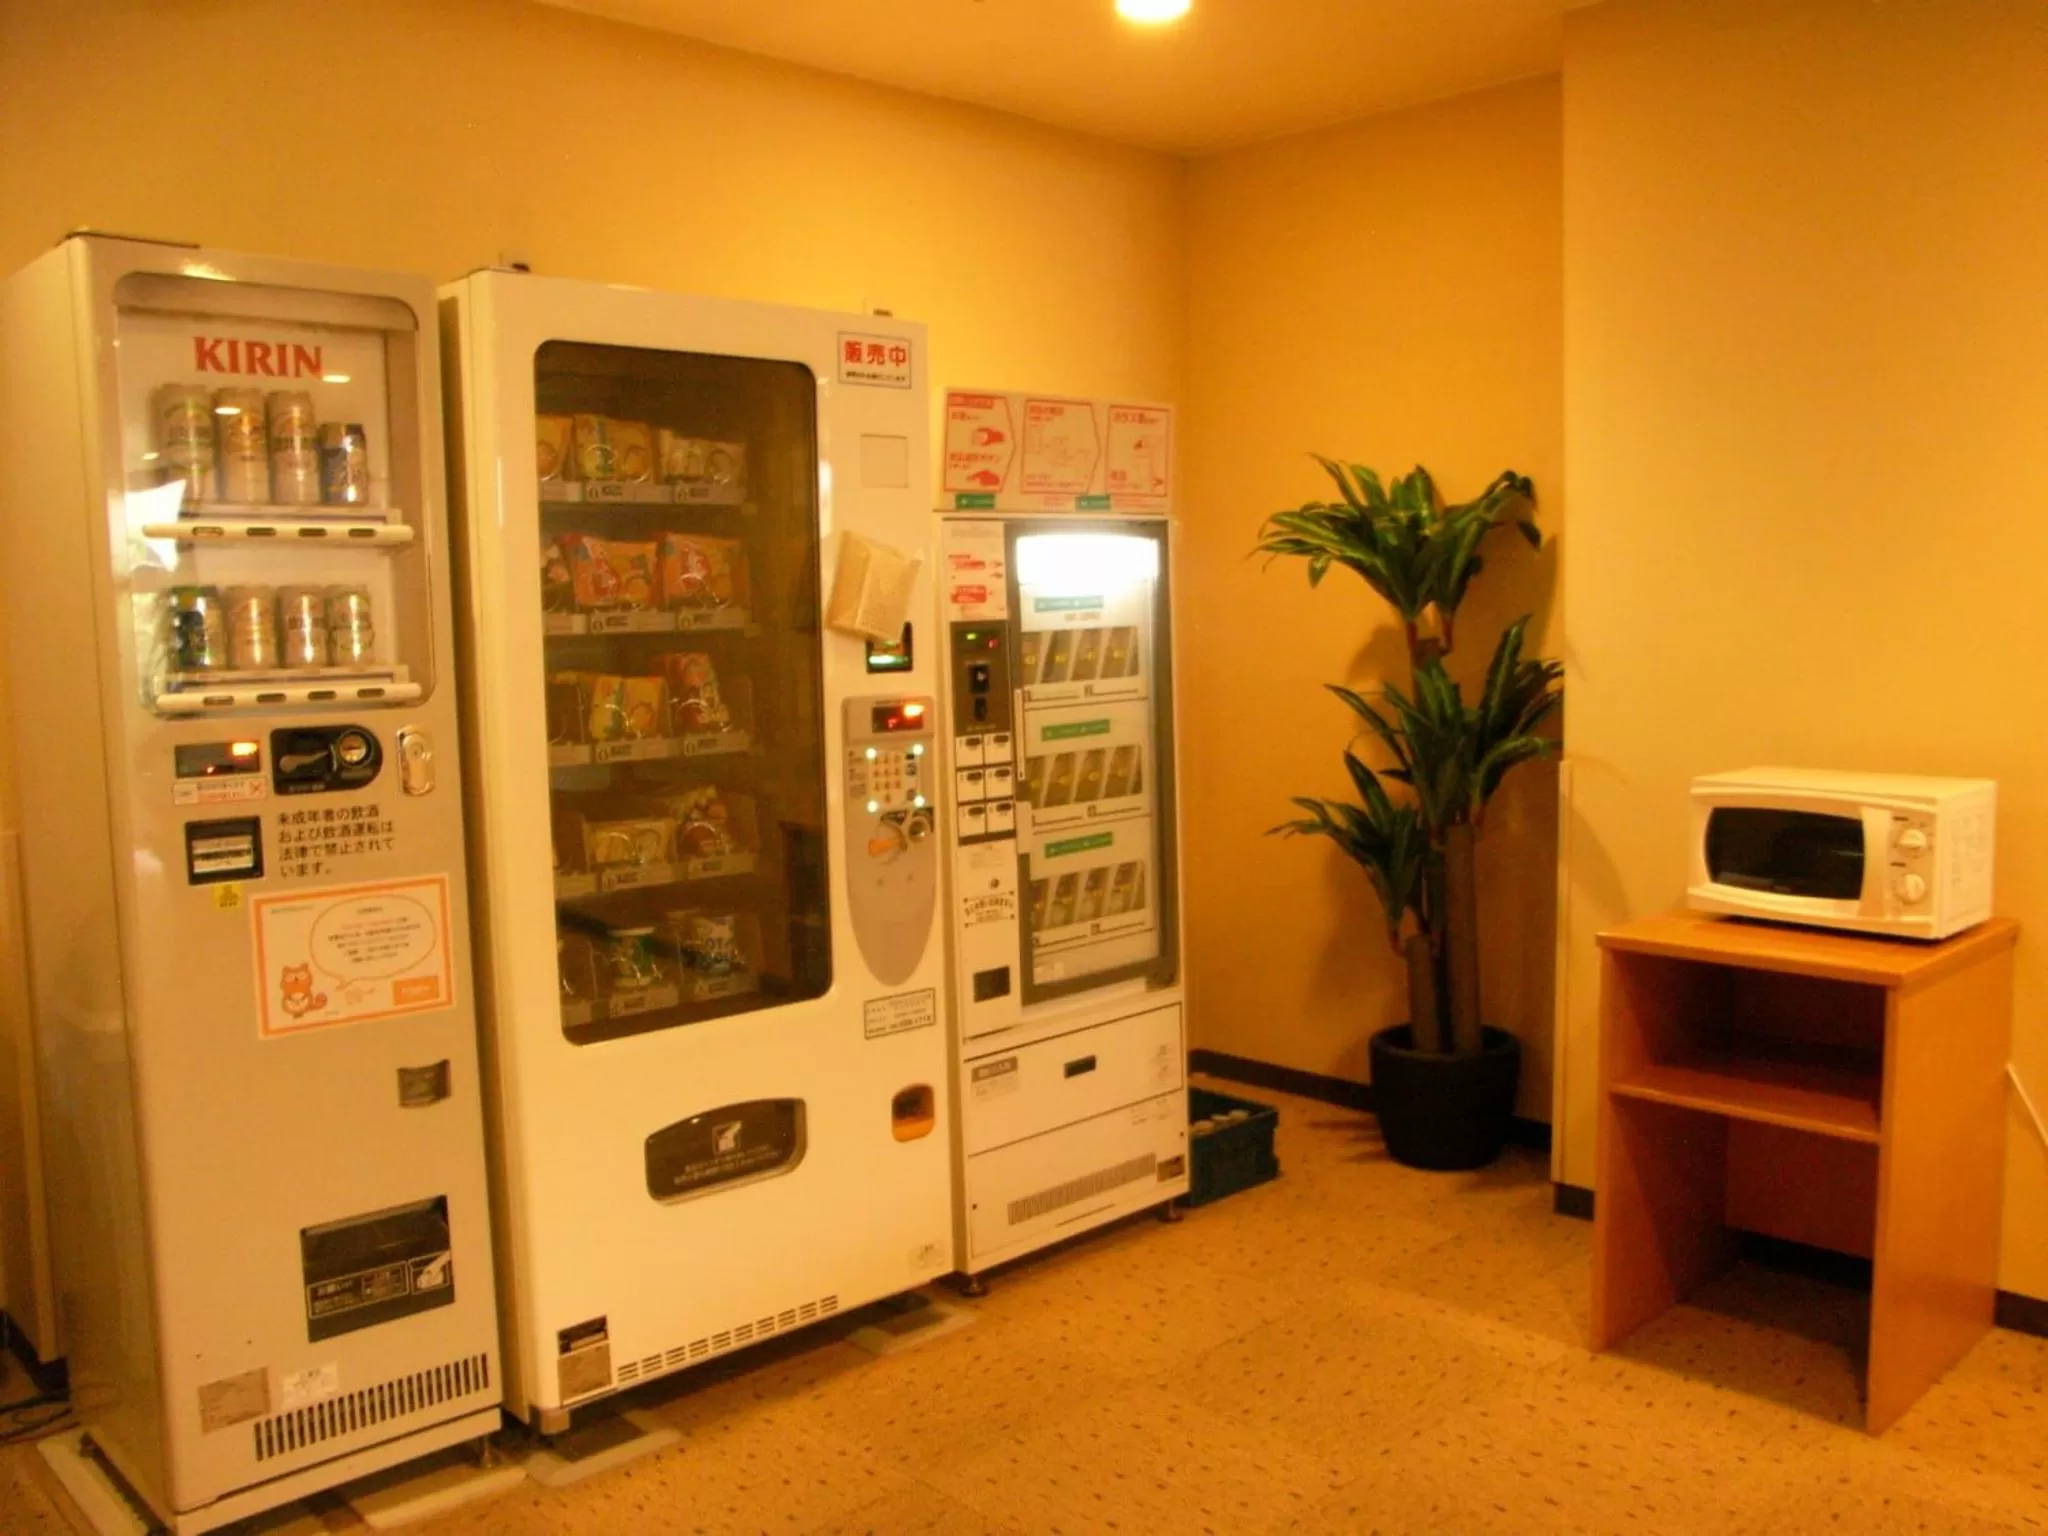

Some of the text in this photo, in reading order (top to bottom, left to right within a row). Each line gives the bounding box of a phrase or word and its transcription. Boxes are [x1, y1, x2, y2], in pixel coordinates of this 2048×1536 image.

[193, 335, 323, 380] KIRIN
[844, 340, 907, 368] 販売中
[279, 804, 380, 825] 未成年者の飲酒
[279, 820, 393, 845] および飲酒運転は
[279, 837, 395, 861] 法律で禁止されて
